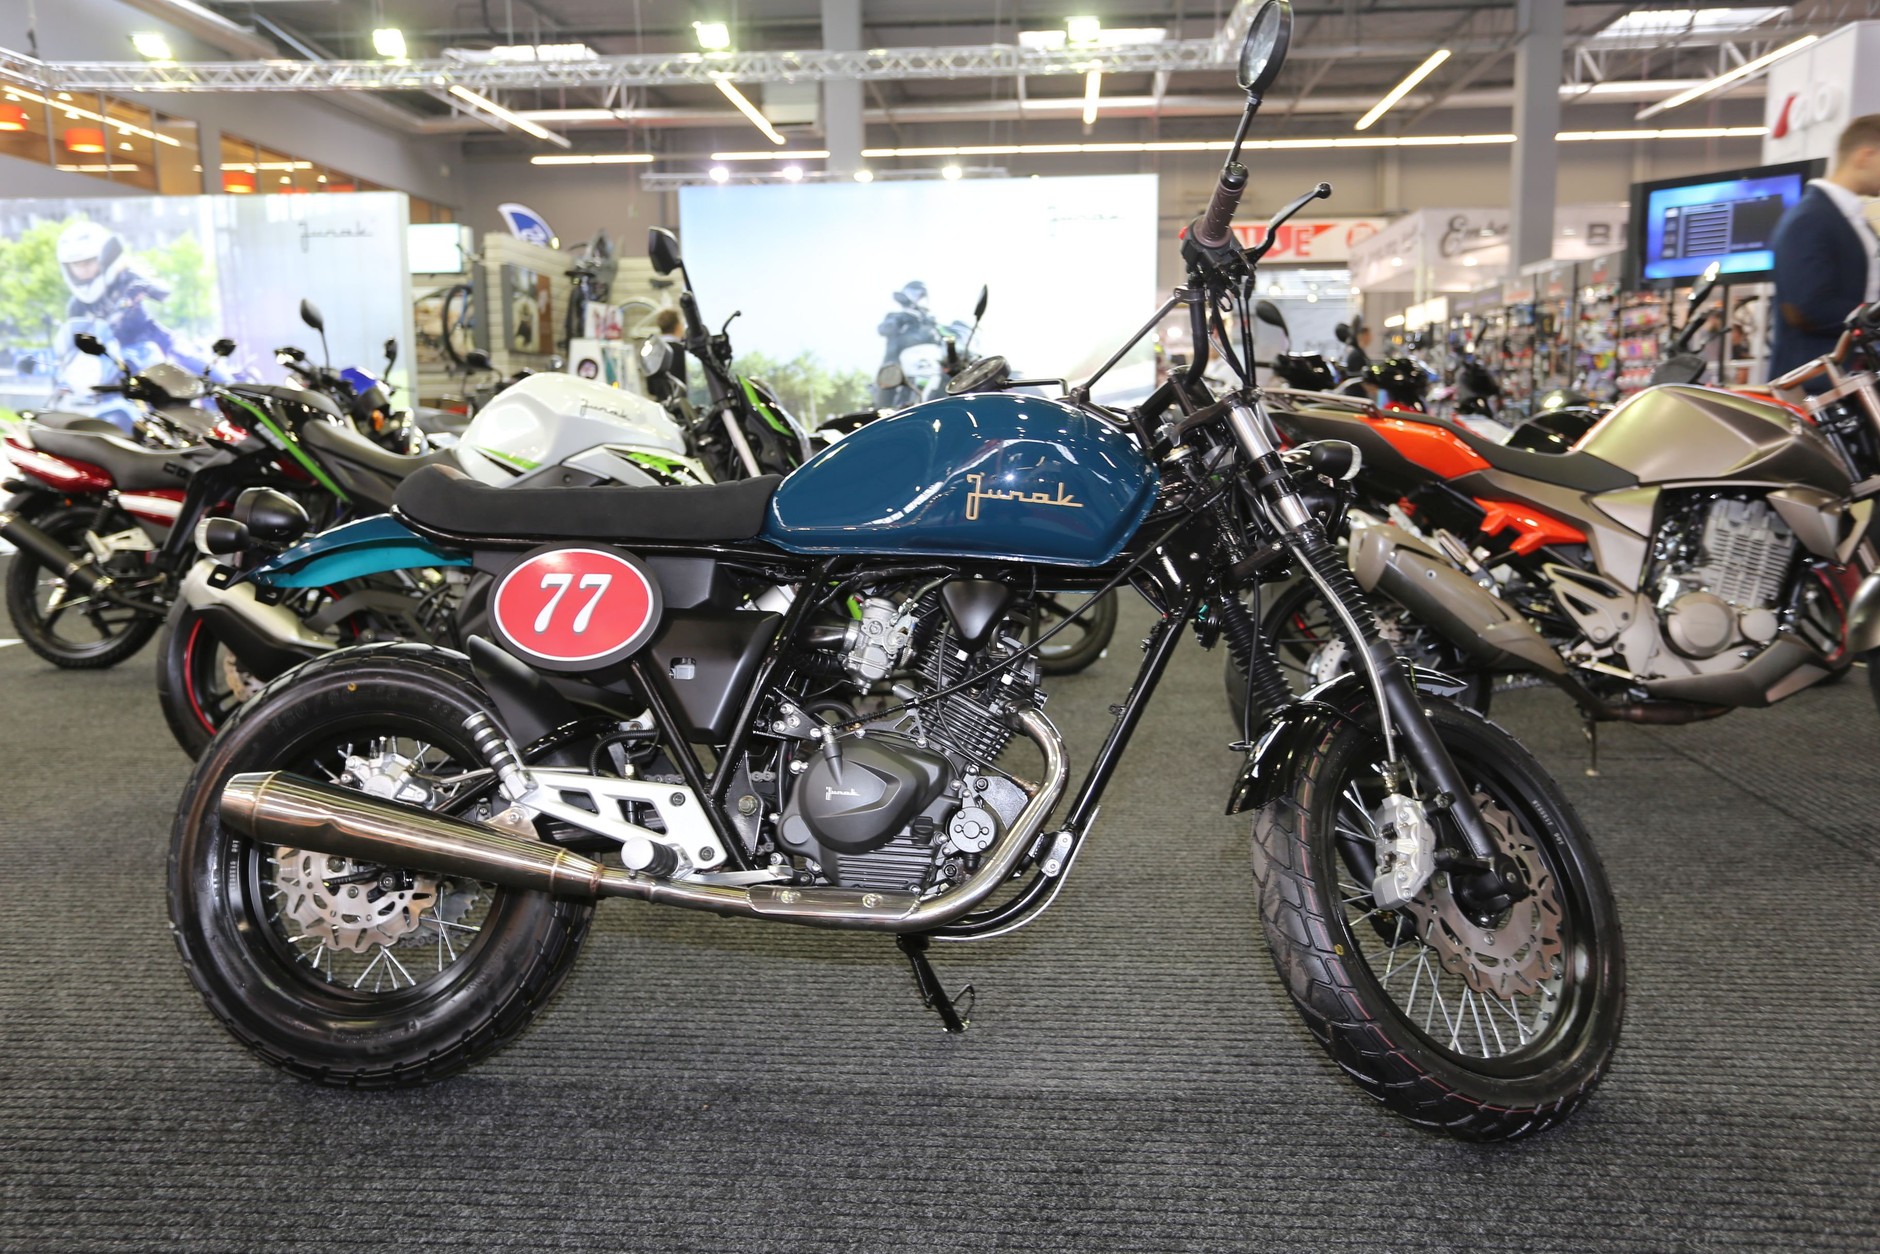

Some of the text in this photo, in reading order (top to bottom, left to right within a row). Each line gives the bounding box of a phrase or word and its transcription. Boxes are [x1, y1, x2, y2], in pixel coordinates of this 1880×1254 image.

[298, 220, 374, 253] Junak
[580, 398, 632, 421] Junak
[965, 472, 1084, 521] Junak
[533, 573, 613, 635] 77
[825, 786, 861, 801] Junak
